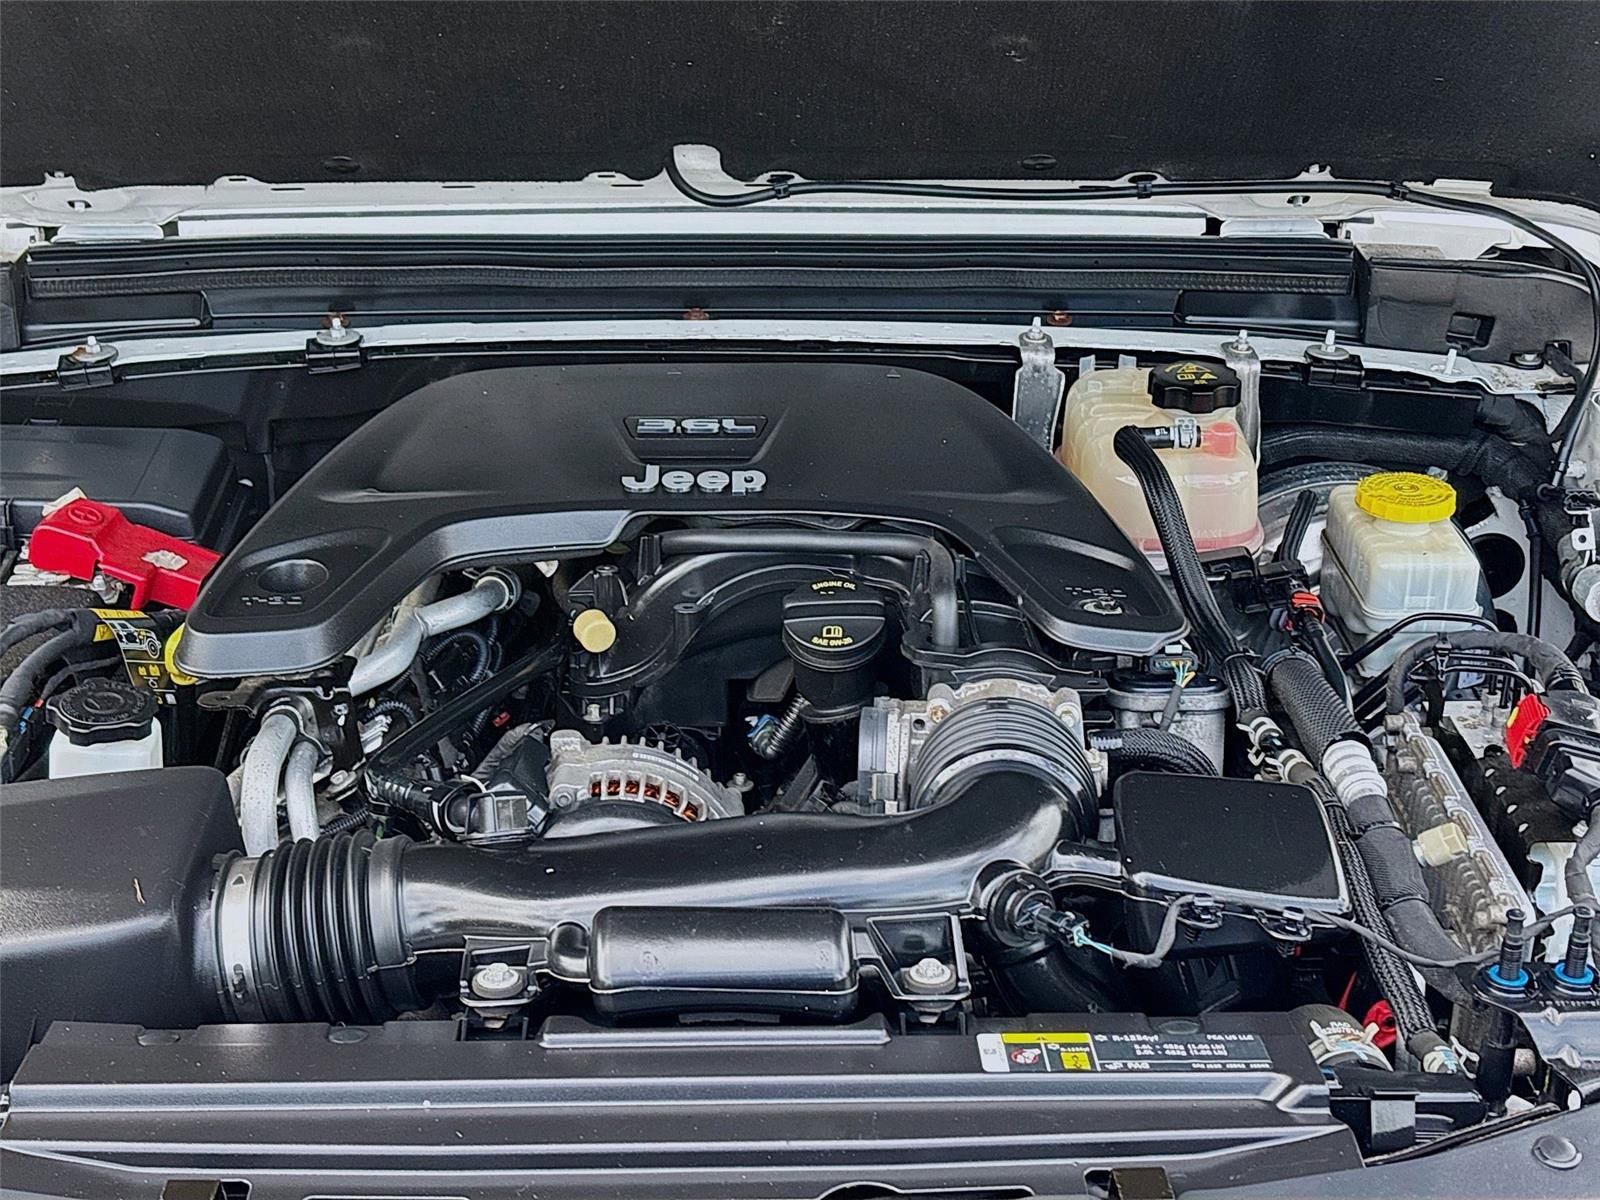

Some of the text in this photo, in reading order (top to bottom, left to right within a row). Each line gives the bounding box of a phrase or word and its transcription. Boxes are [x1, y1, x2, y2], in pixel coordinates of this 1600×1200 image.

[637, 418, 756, 435] 3.6L
[621, 464, 767, 497] Jeep
[811, 581, 856, 590] ENGINE OIL
[811, 636, 829, 646] SAE
